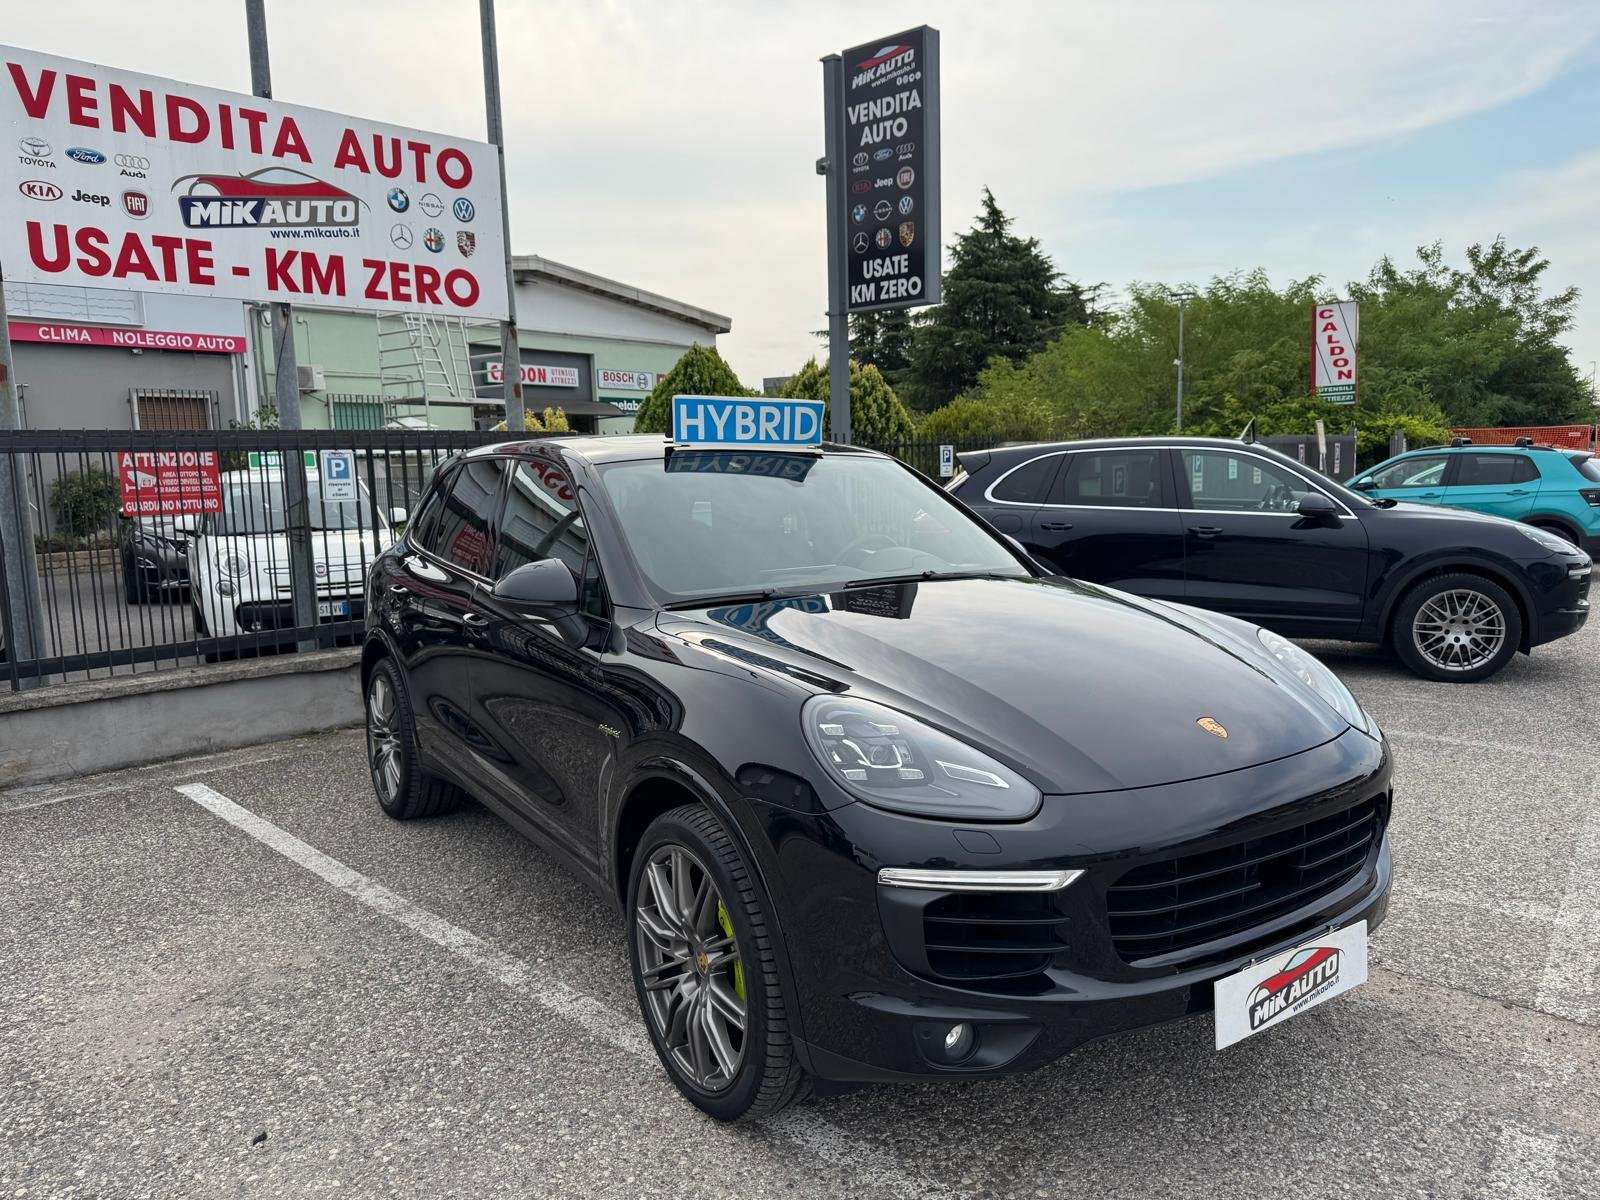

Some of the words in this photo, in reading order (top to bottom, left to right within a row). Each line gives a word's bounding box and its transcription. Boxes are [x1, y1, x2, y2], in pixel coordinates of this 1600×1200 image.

[847, 88, 922, 126] VENDITA
[6, 62, 313, 164] VENDITA
[334, 128, 473, 190] AUTO
[860, 116, 908, 147] AUTO
[18, 155, 57, 169] TOYOTA
[72, 148, 100, 164] Ford
[120, 168, 147, 180] Audi
[874, 177, 894, 188] Jeep
[26, 183, 57, 198] KIA
[71, 189, 112, 207] Jeep
[127, 196, 146, 212] FIAT
[259, 200, 356, 225] AUTO
[270, 227, 360, 240] www.mikauto.it
[26, 221, 215, 286] USATE
[265, 247, 347, 297] KM
[362, 258, 480, 308] ZERO
[862, 254, 909, 279] USATE
[851, 282, 876, 304] KM
[880, 276, 922, 300] ZERO
[38, 326, 92, 342] CLIMA
[113, 331, 193, 348] NOLEGGIO
[197, 337, 235, 350] AUTO
[1319, 309, 1352, 380] CALDON
[603, 372, 634, 383] BOSCH
[680, 404, 818, 441] HYBRID
[331, 459, 345, 478] P
[1288, 953, 1338, 1003] AUTO
[1292, 974, 1340, 1013] www.mikauto.it
